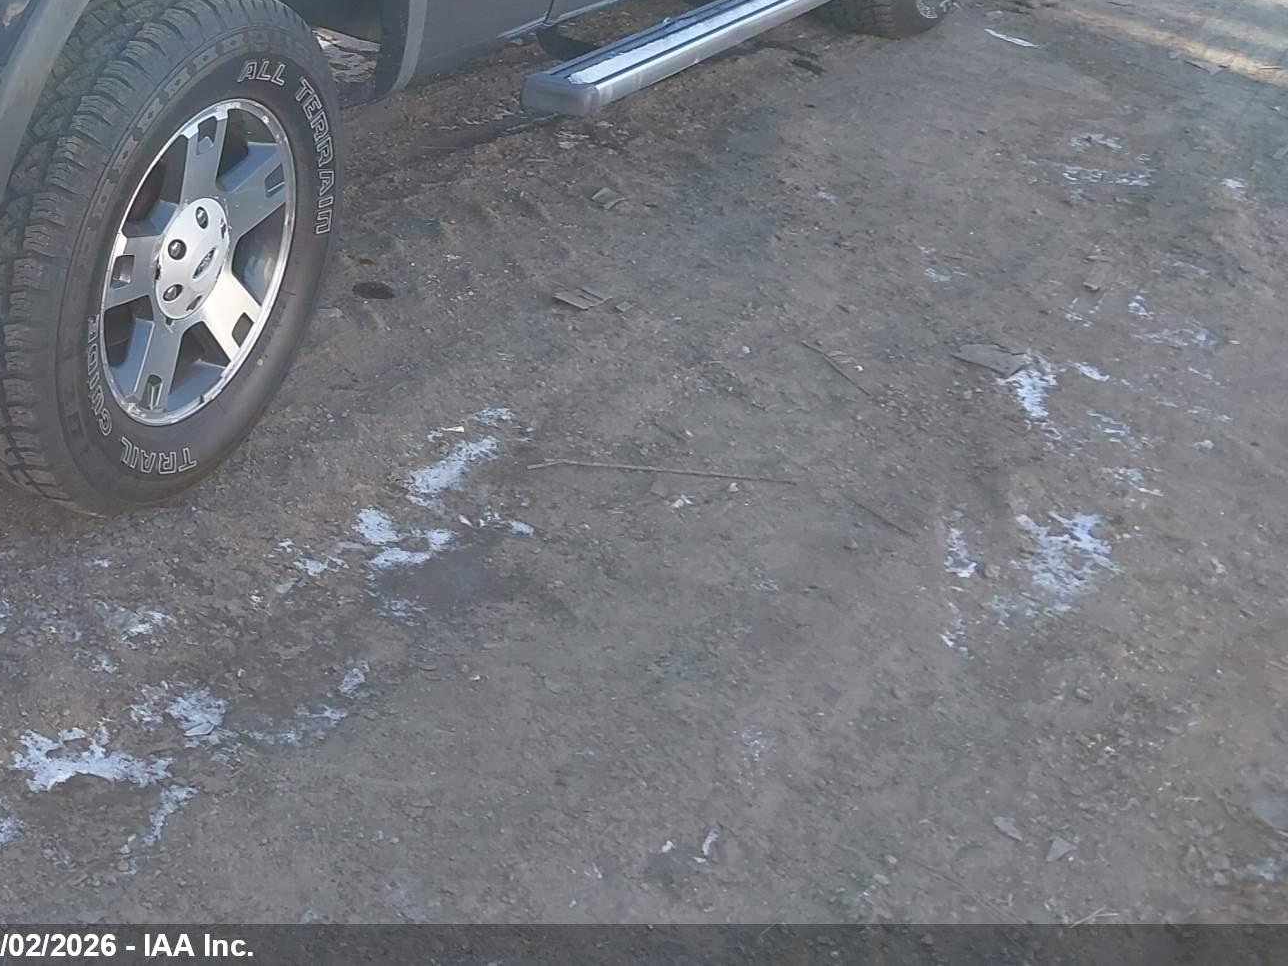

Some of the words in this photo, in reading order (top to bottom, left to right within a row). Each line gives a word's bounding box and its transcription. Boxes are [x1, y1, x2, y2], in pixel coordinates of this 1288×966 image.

[237, 60, 287, 86] ALL
[295, 77, 335, 235] TERRAIN
[120, 436, 197, 474] TRAIL
